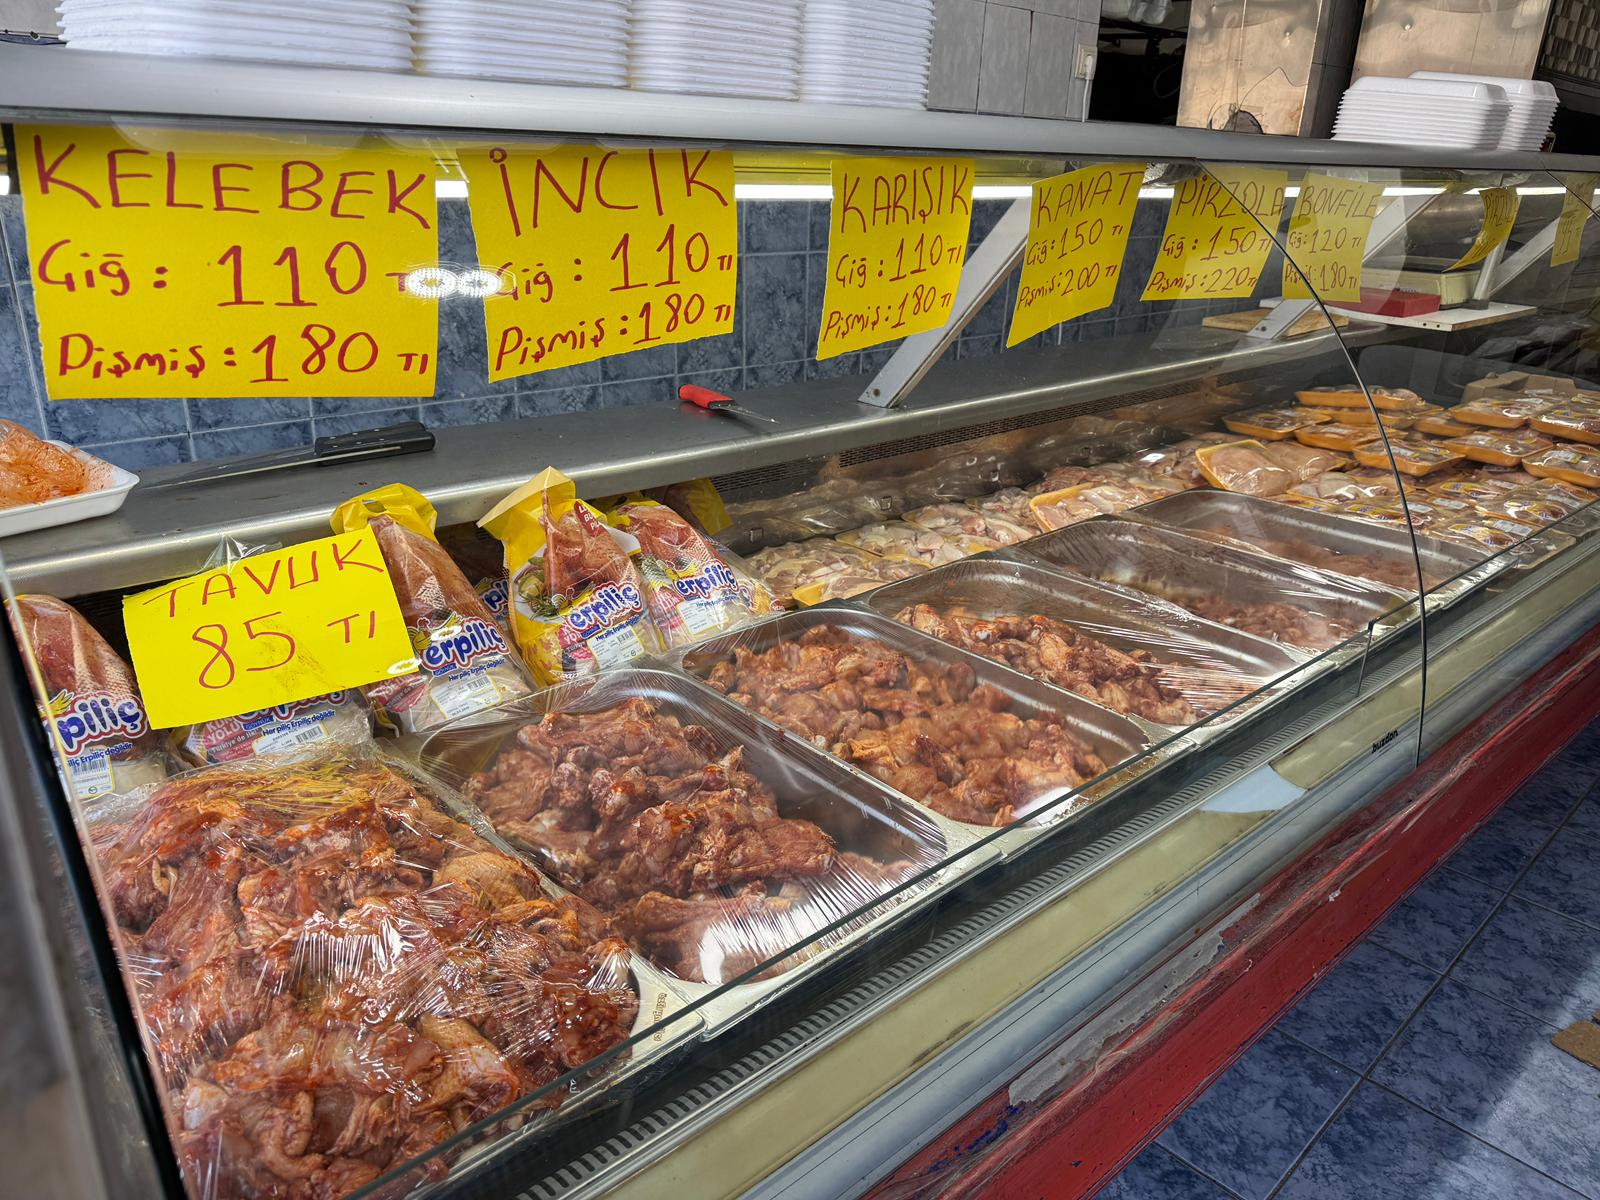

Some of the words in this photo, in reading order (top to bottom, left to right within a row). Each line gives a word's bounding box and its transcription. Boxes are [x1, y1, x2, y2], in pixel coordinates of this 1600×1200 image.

[34, 134, 430, 229] KELEBEK
[841, 164, 969, 233] KARIŞIK
[1037, 170, 1145, 228] KANAT
[1176, 174, 1285, 219] PİRZOLA
[609, 224, 710, 292] 110
[889, 233, 943, 282] 110
[1059, 218, 1103, 259] 150
[1200, 226, 1257, 261] 150
[1309, 227, 1348, 254] 120
[216, 241, 368, 306] 110
[1060, 263, 1100, 297] 200
[1205, 266, 1250, 293] 220
[633, 293, 704, 344] 180
[891, 284, 936, 329] 180
[249, 323, 380, 383] 180
[143, 539, 384, 618] TAVUK
[677, 564, 737, 596] erpiliç
[570, 586, 640, 629] erpiliç
[192, 611, 295, 690] 85
[426, 621, 507, 665] erpiliç
[58, 698, 140, 749] piliç
[263, 727, 275, 737] Her
